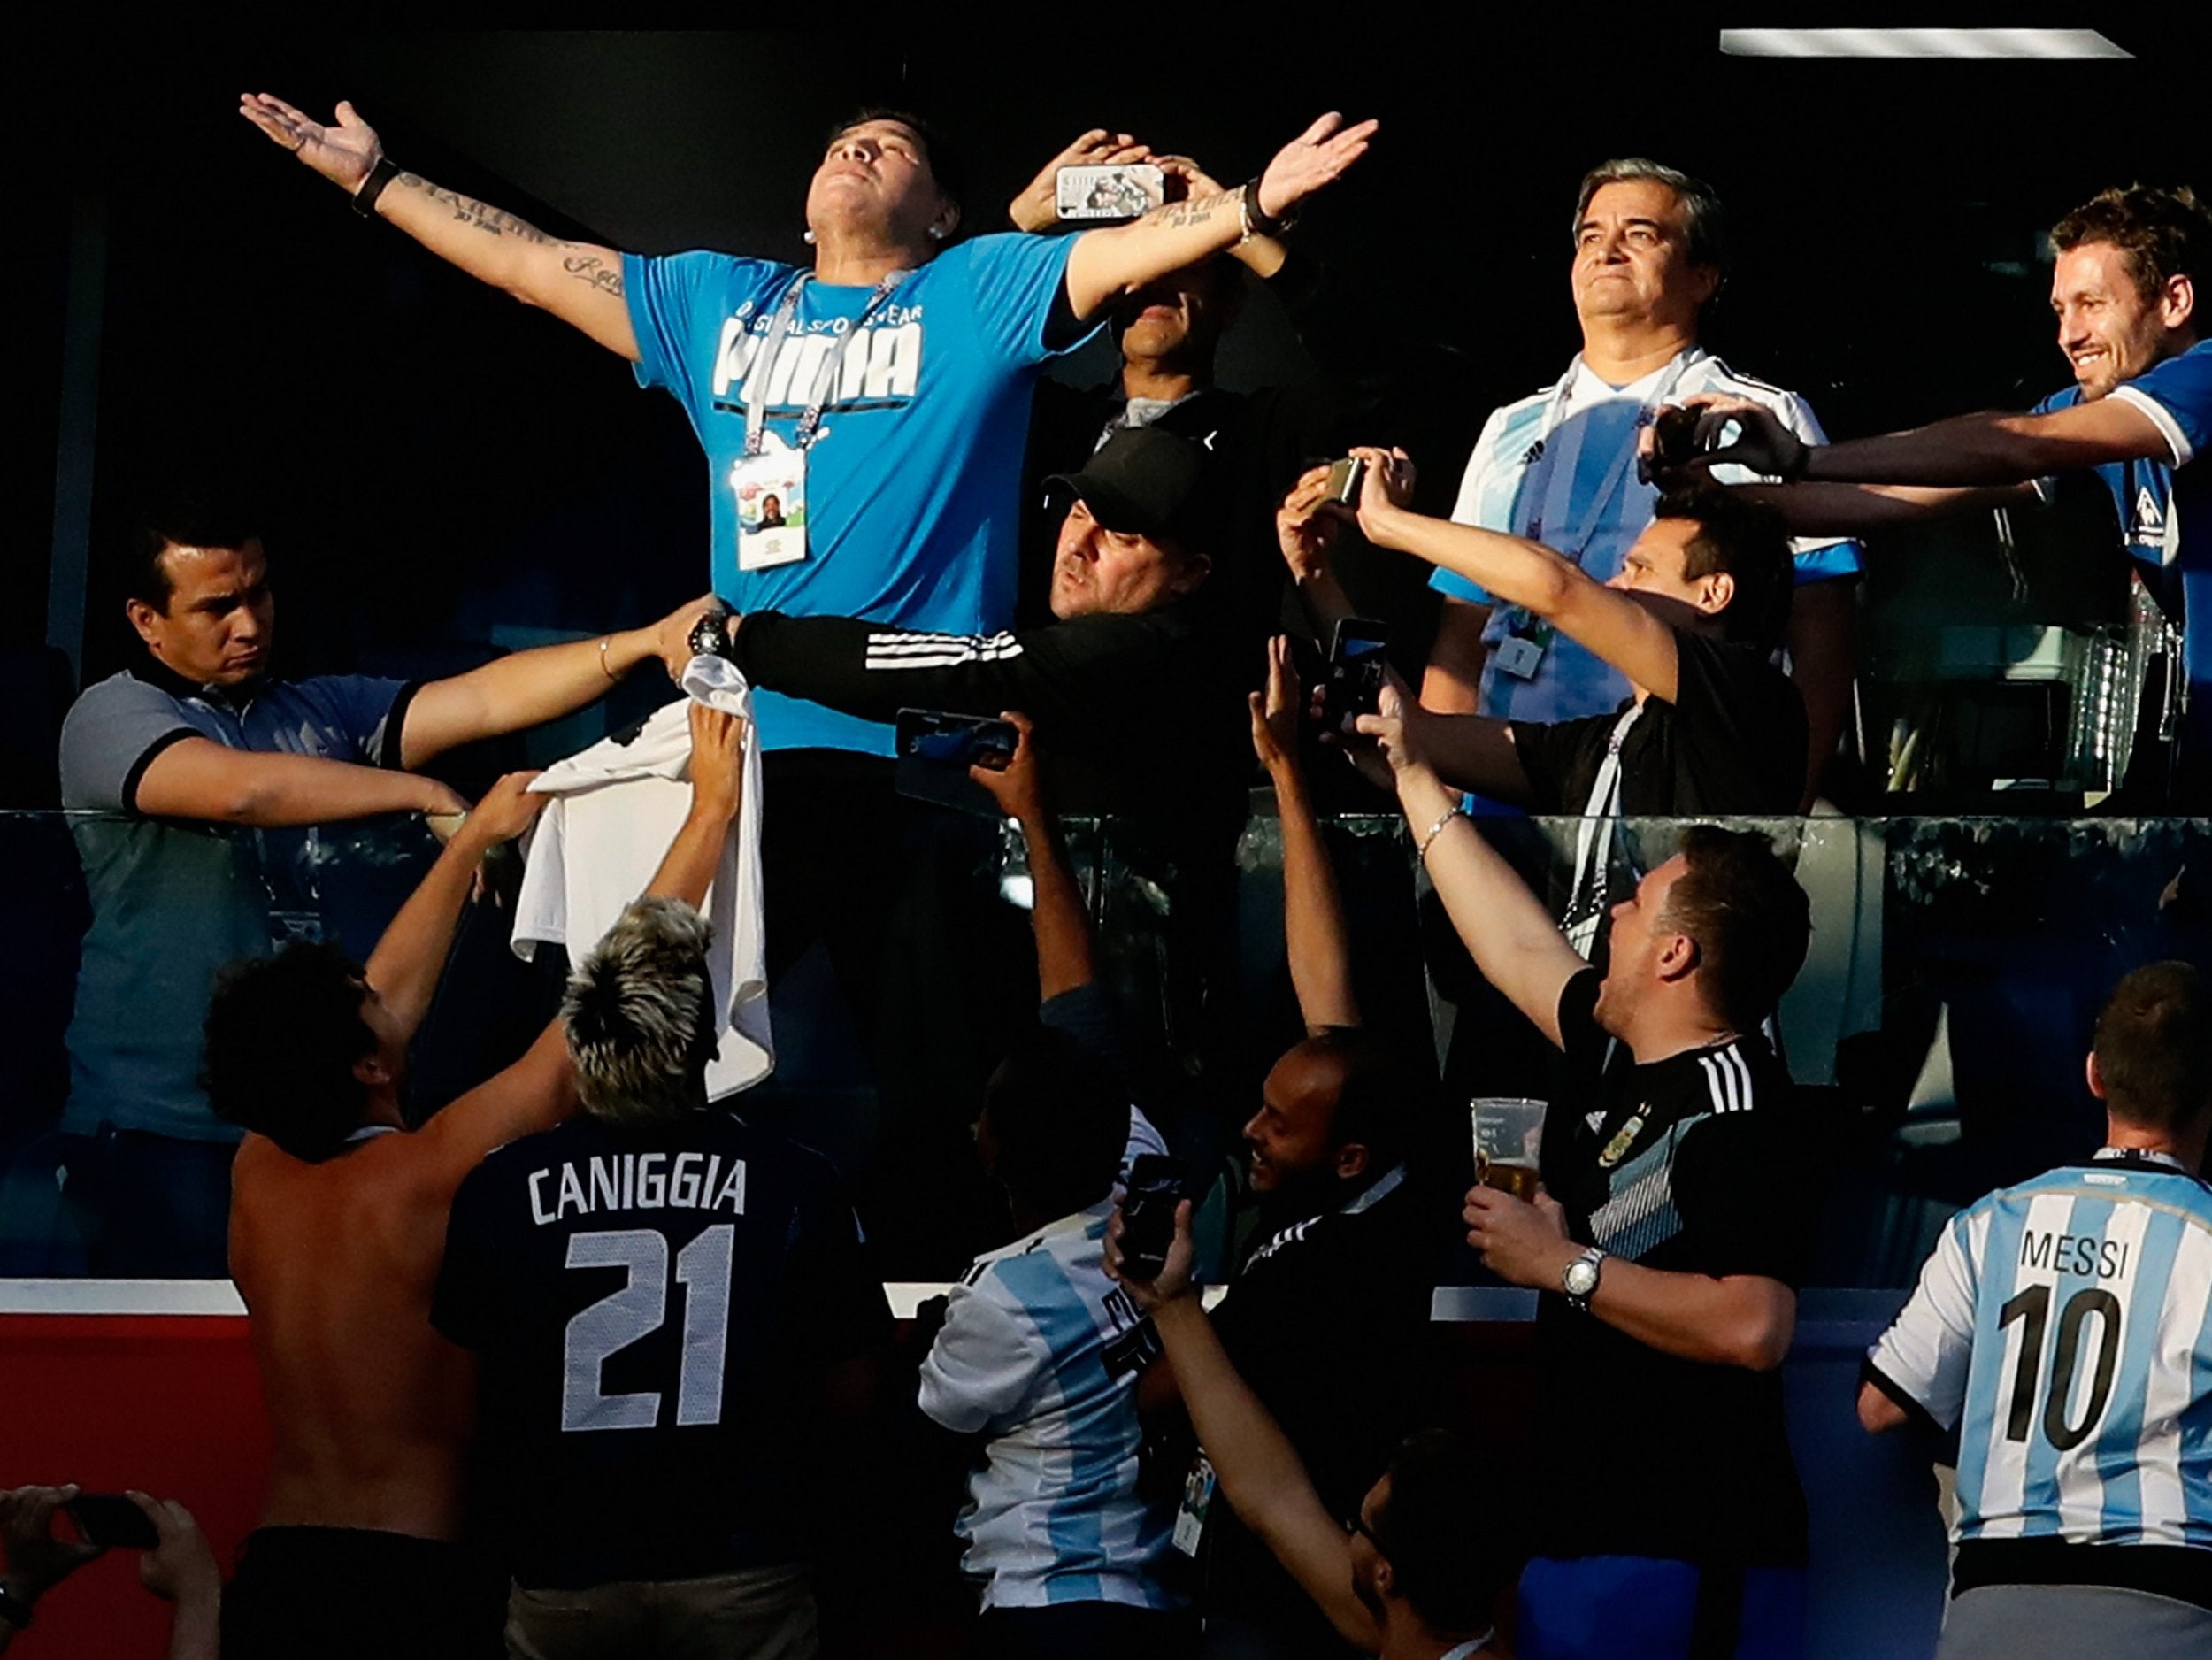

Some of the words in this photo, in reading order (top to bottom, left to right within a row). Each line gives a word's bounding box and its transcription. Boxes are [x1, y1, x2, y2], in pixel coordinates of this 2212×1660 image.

[712, 316, 921, 405] PUMA
[528, 1152, 746, 1226] CANIGGIA
[2021, 1230, 2129, 1279] MESSI
[562, 1224, 734, 1431] 21
[1998, 1283, 2122, 1452] 10
